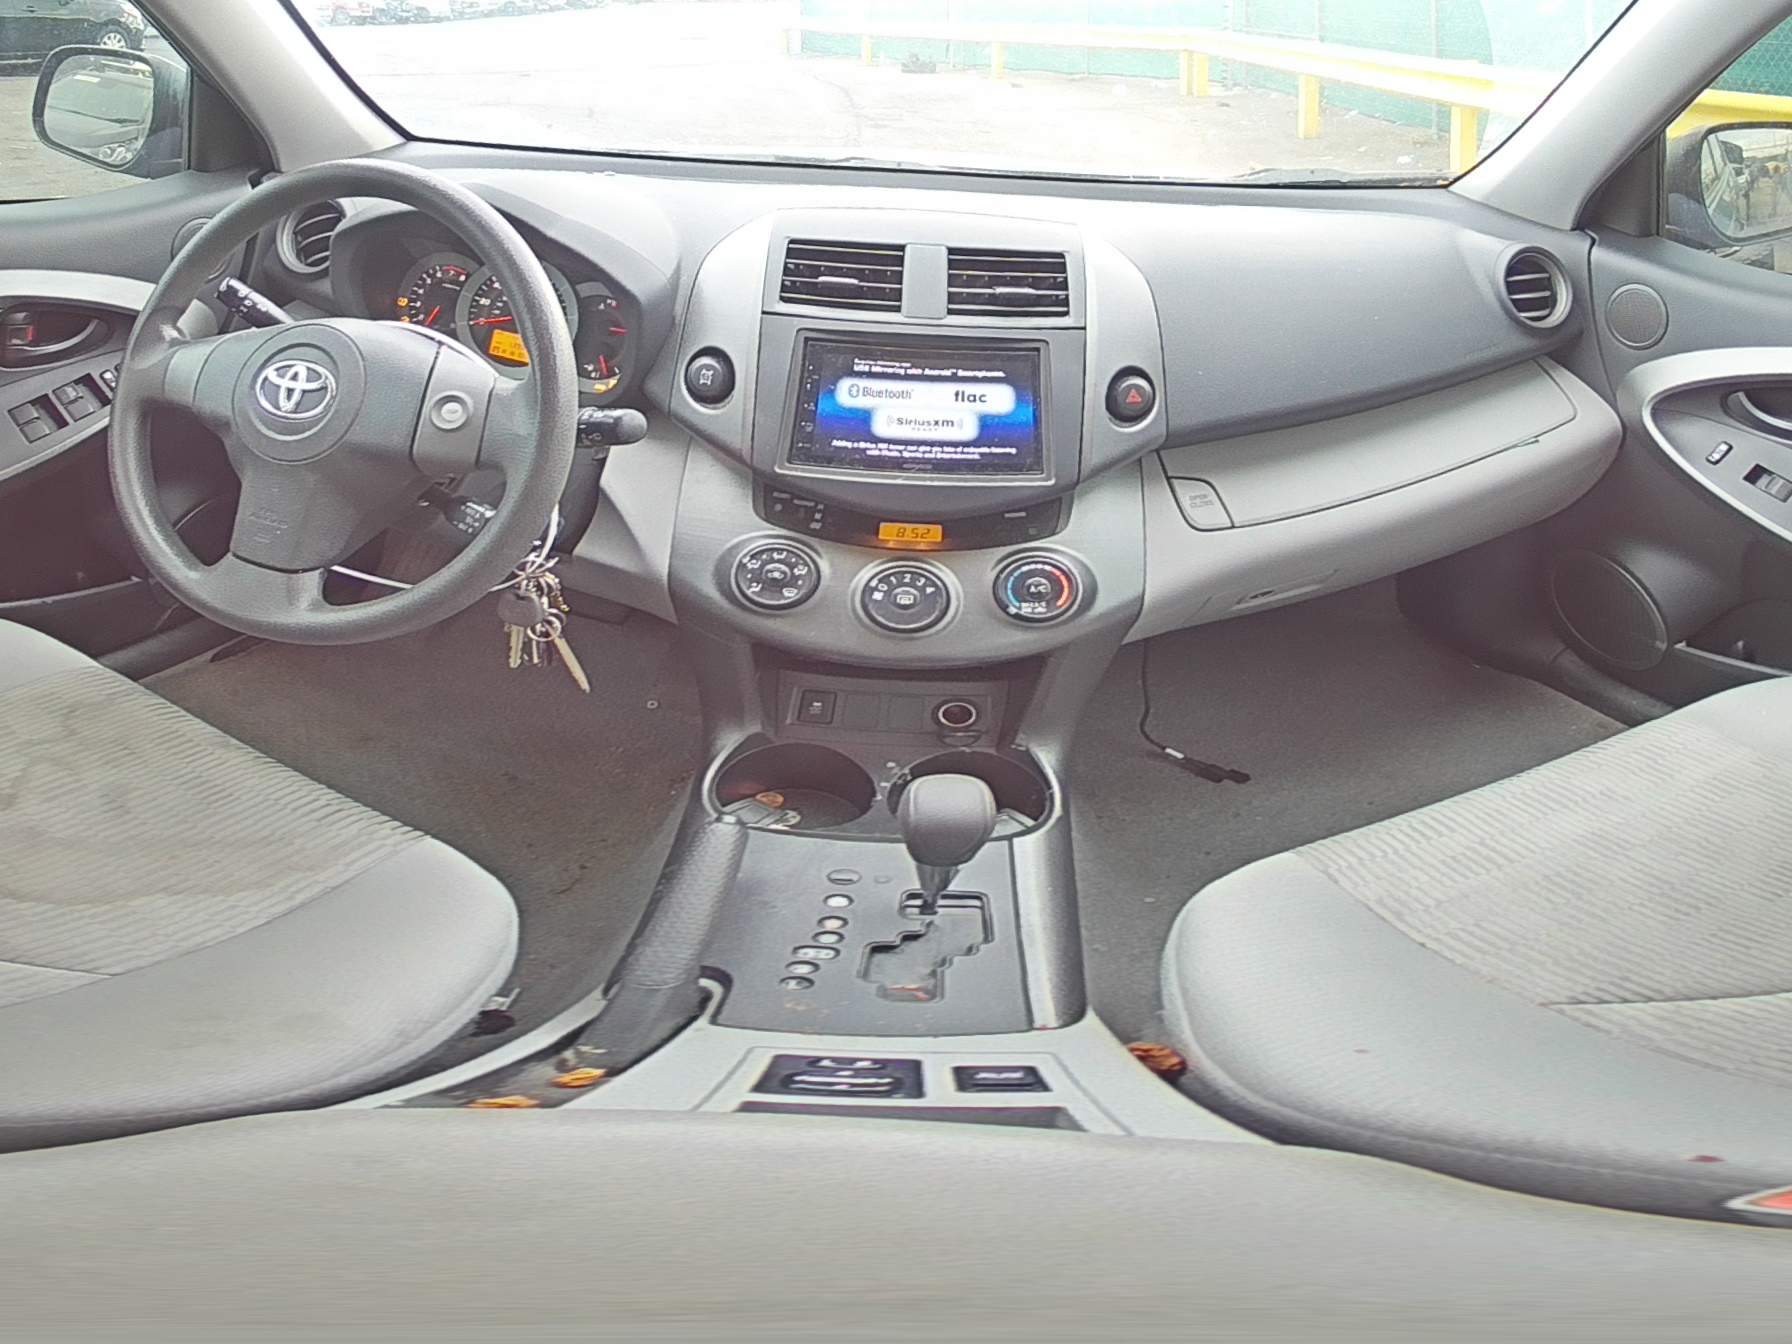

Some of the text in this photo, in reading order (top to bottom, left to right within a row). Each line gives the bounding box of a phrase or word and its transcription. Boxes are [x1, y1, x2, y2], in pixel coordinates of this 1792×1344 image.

[954, 390, 987, 403] flac
[890, 576, 897, 584] 1
[903, 574, 911, 582] 2
[916, 577, 926, 586] 3
